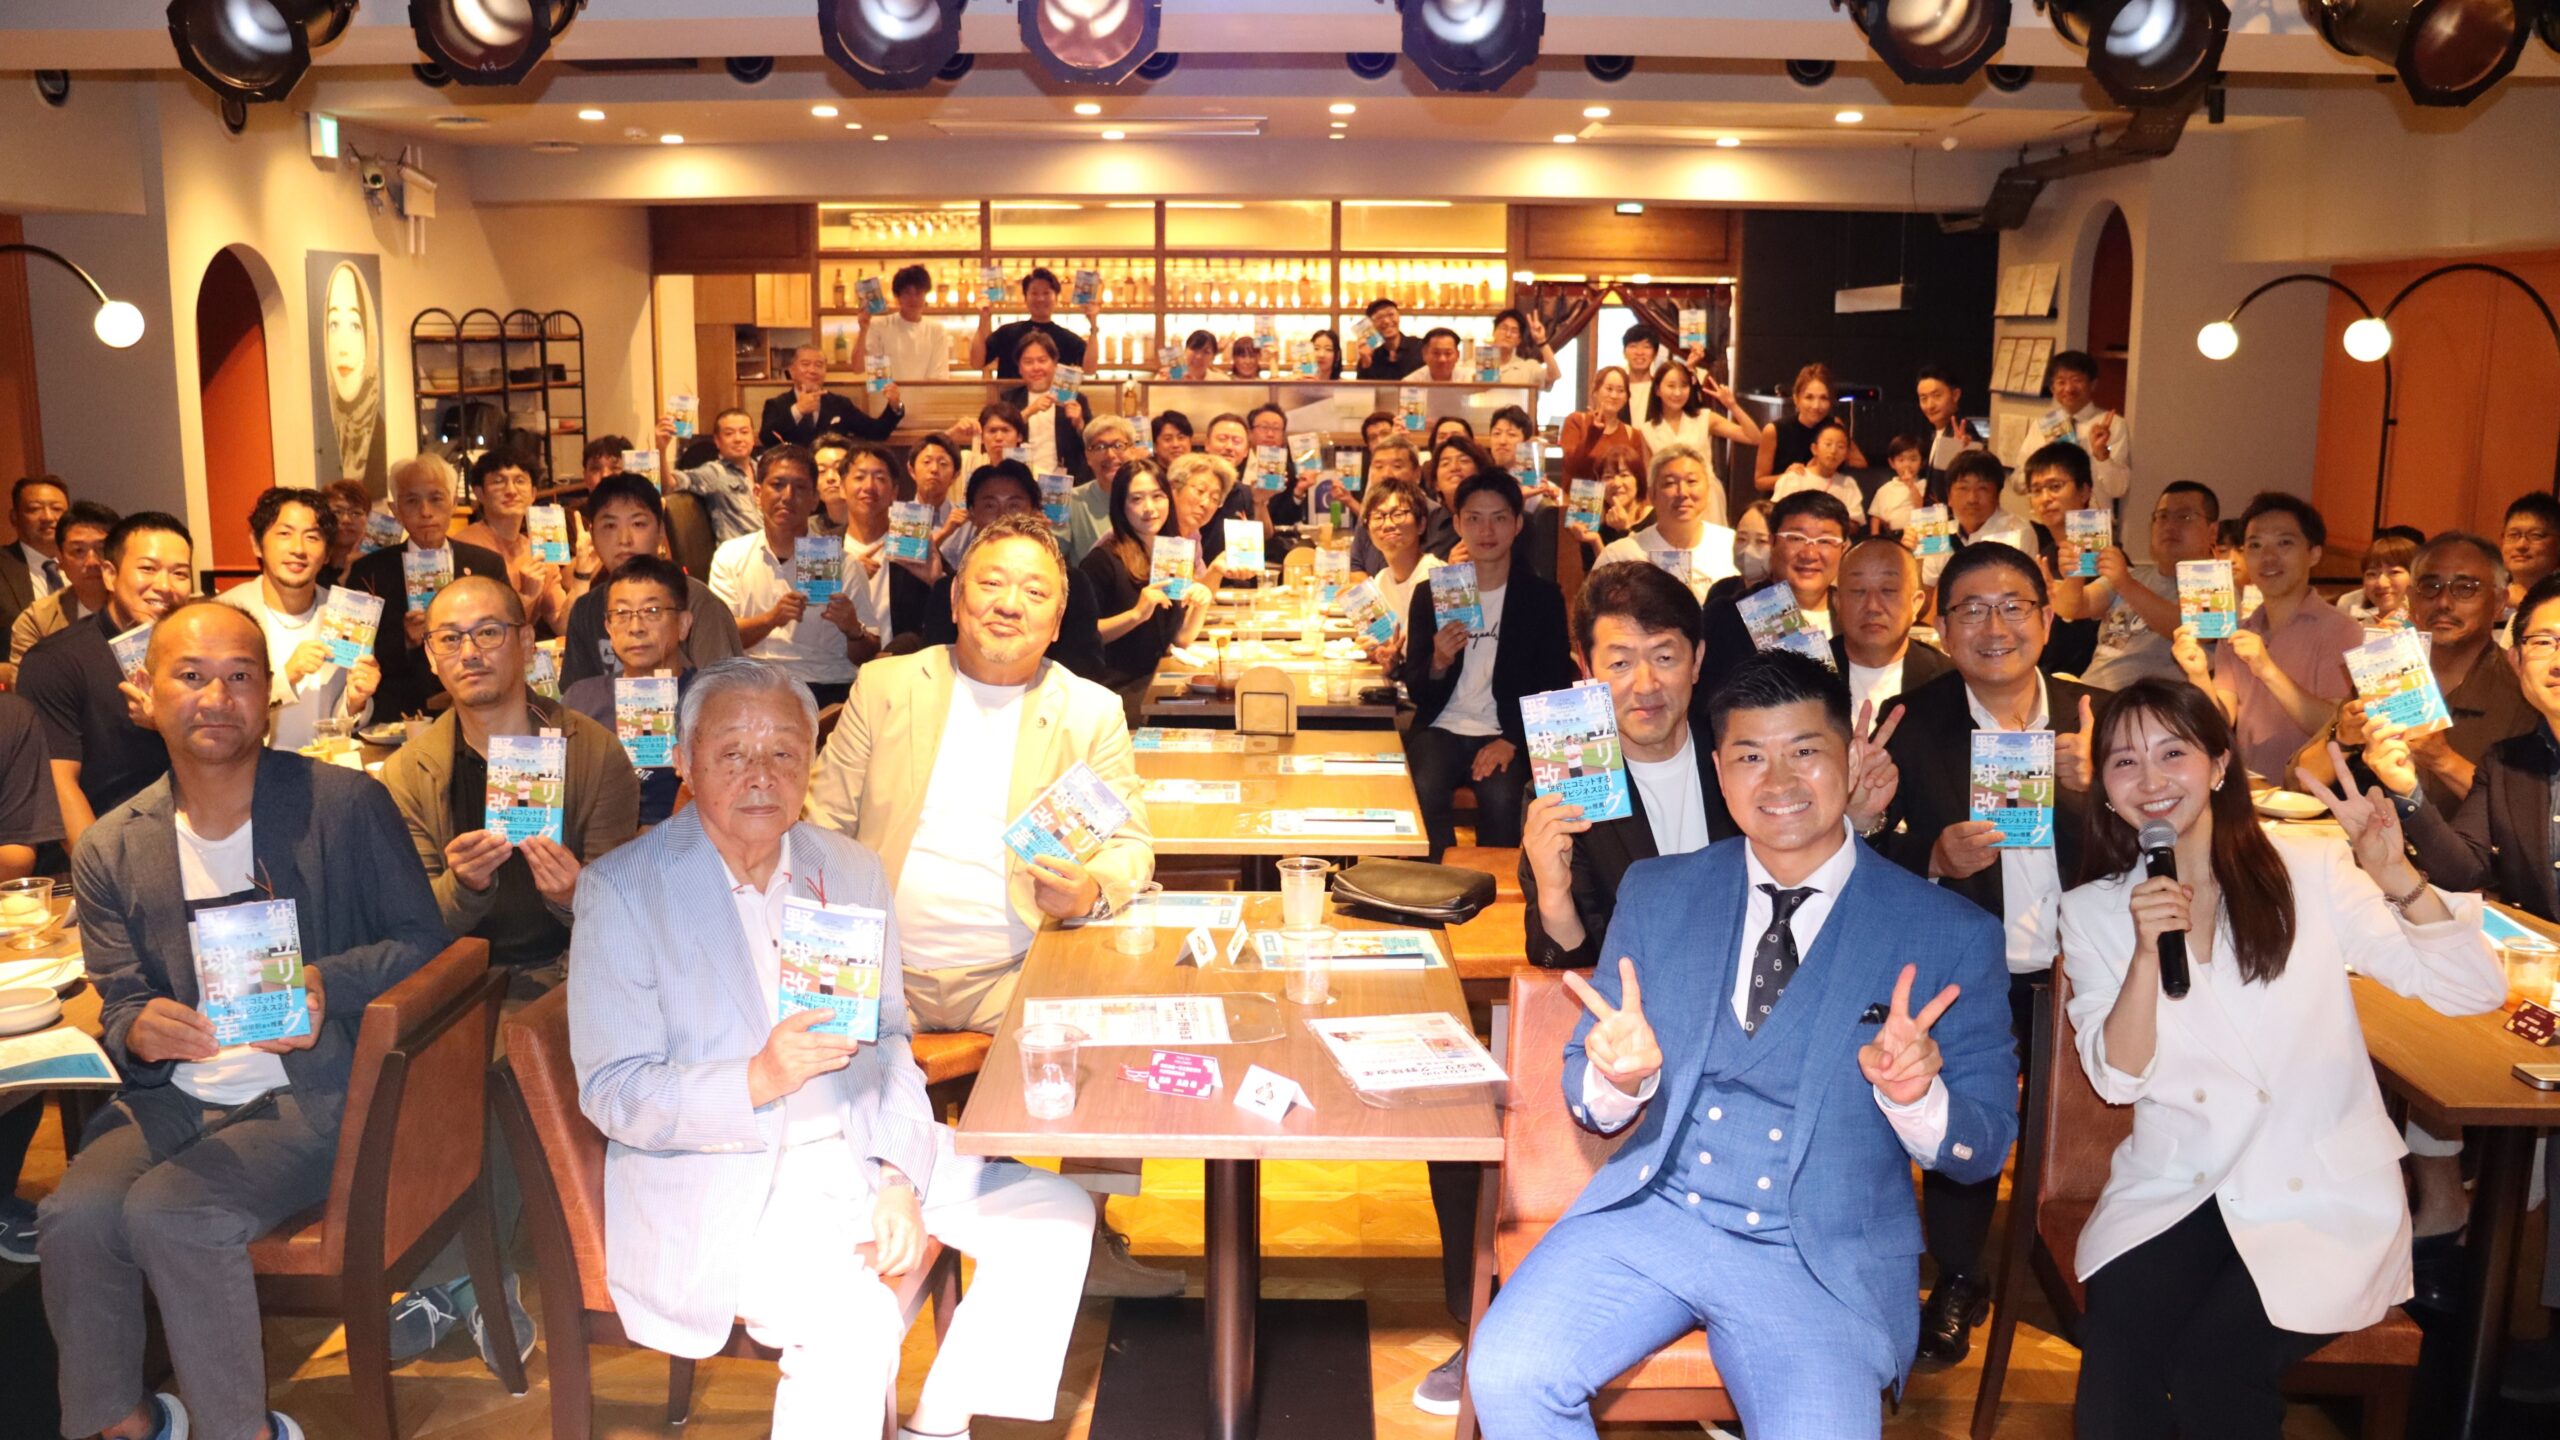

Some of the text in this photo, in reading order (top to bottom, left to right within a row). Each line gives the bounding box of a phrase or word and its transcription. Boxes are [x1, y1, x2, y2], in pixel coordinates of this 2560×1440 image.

[1582, 687, 1625, 816] 独立リーグ
[2029, 734, 2051, 845] 独立リーグ
